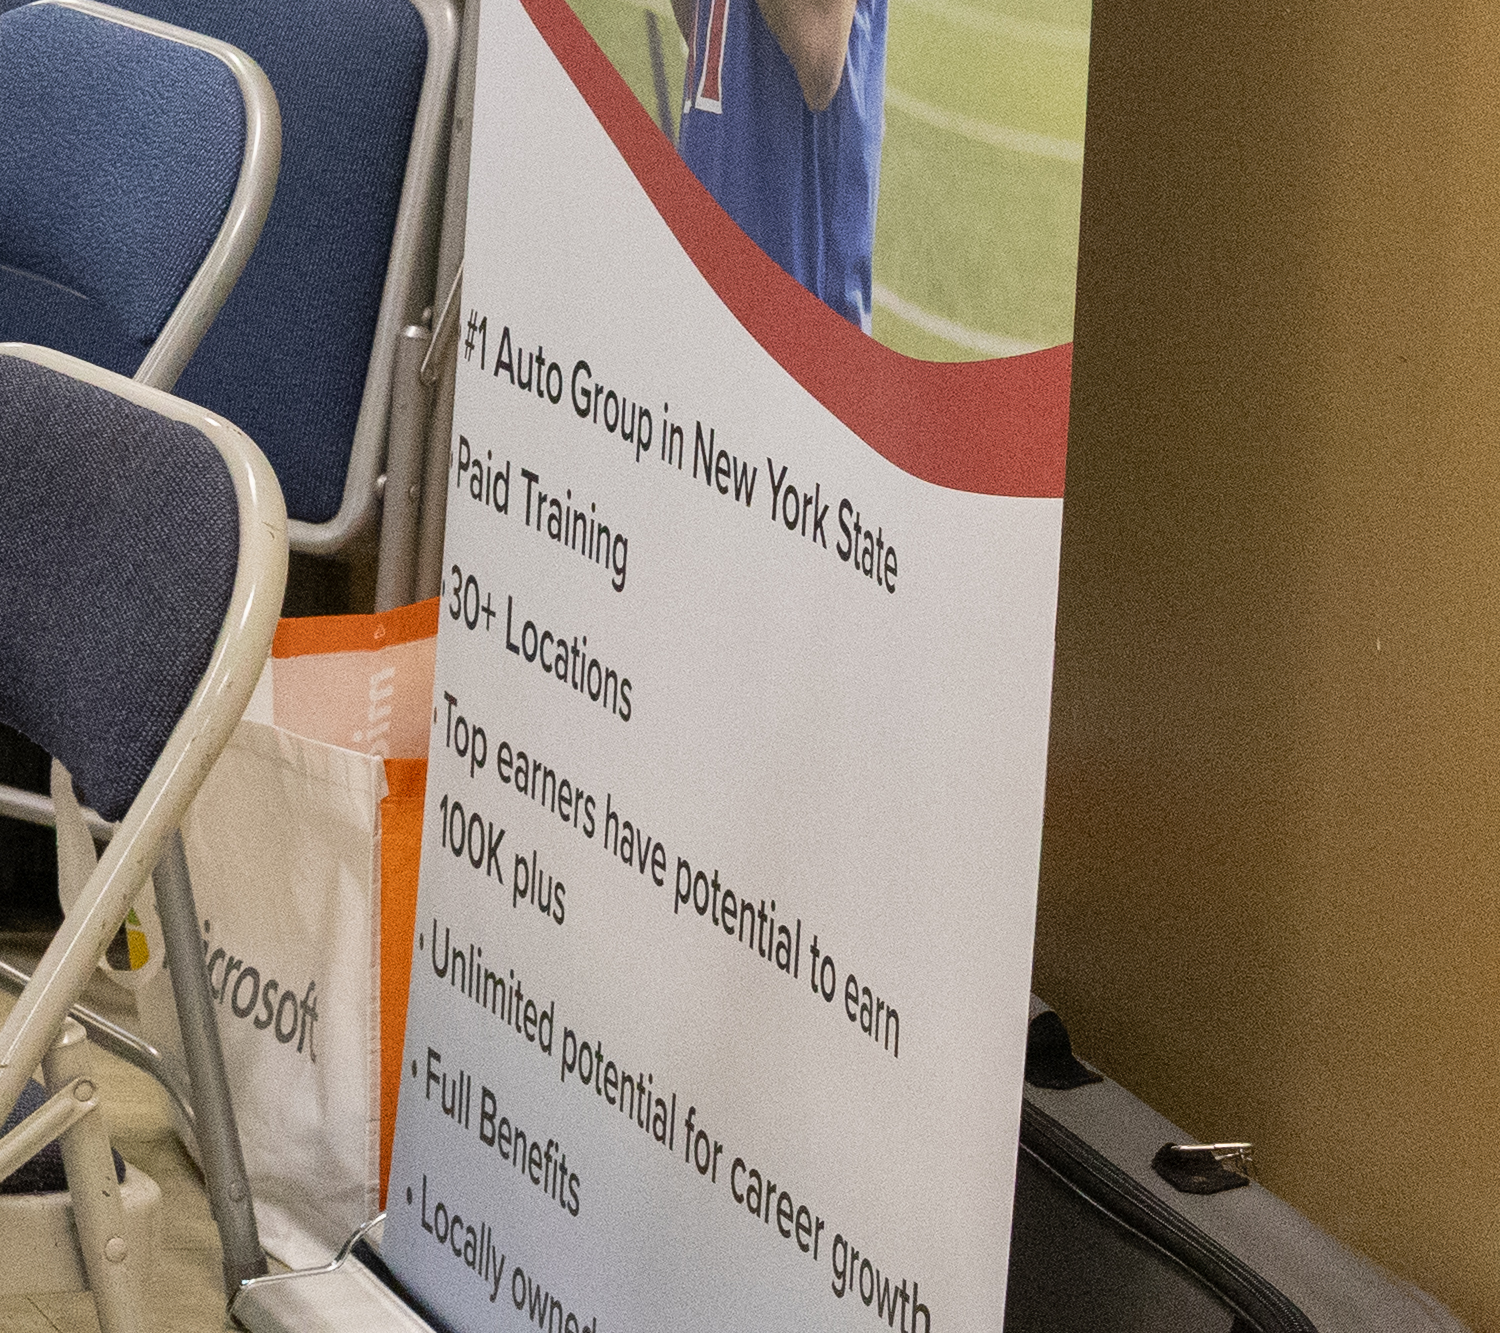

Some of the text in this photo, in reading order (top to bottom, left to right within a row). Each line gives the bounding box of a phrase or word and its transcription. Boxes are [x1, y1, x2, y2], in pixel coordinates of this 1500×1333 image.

[456, 433, 630, 593] Paid Training
[463, 307, 899, 594] #1 Auto Group in New York State
[448, 564, 497, 633] 30+
[505, 595, 633, 722] Locations
[439, 792, 565, 926] 100K plus
[443, 690, 488, 777] Top
[497, 740, 596, 839] earners
[603, 793, 667, 887] have
[674, 854, 802, 979] potential
[808, 935, 837, 1002] to
[844, 972, 901, 1059] earn
[425, 1046, 581, 1218] Full Benefits
[431, 917, 932, 1333] Unlimited potential for career growth
[420, 1174, 506, 1303] Locally
